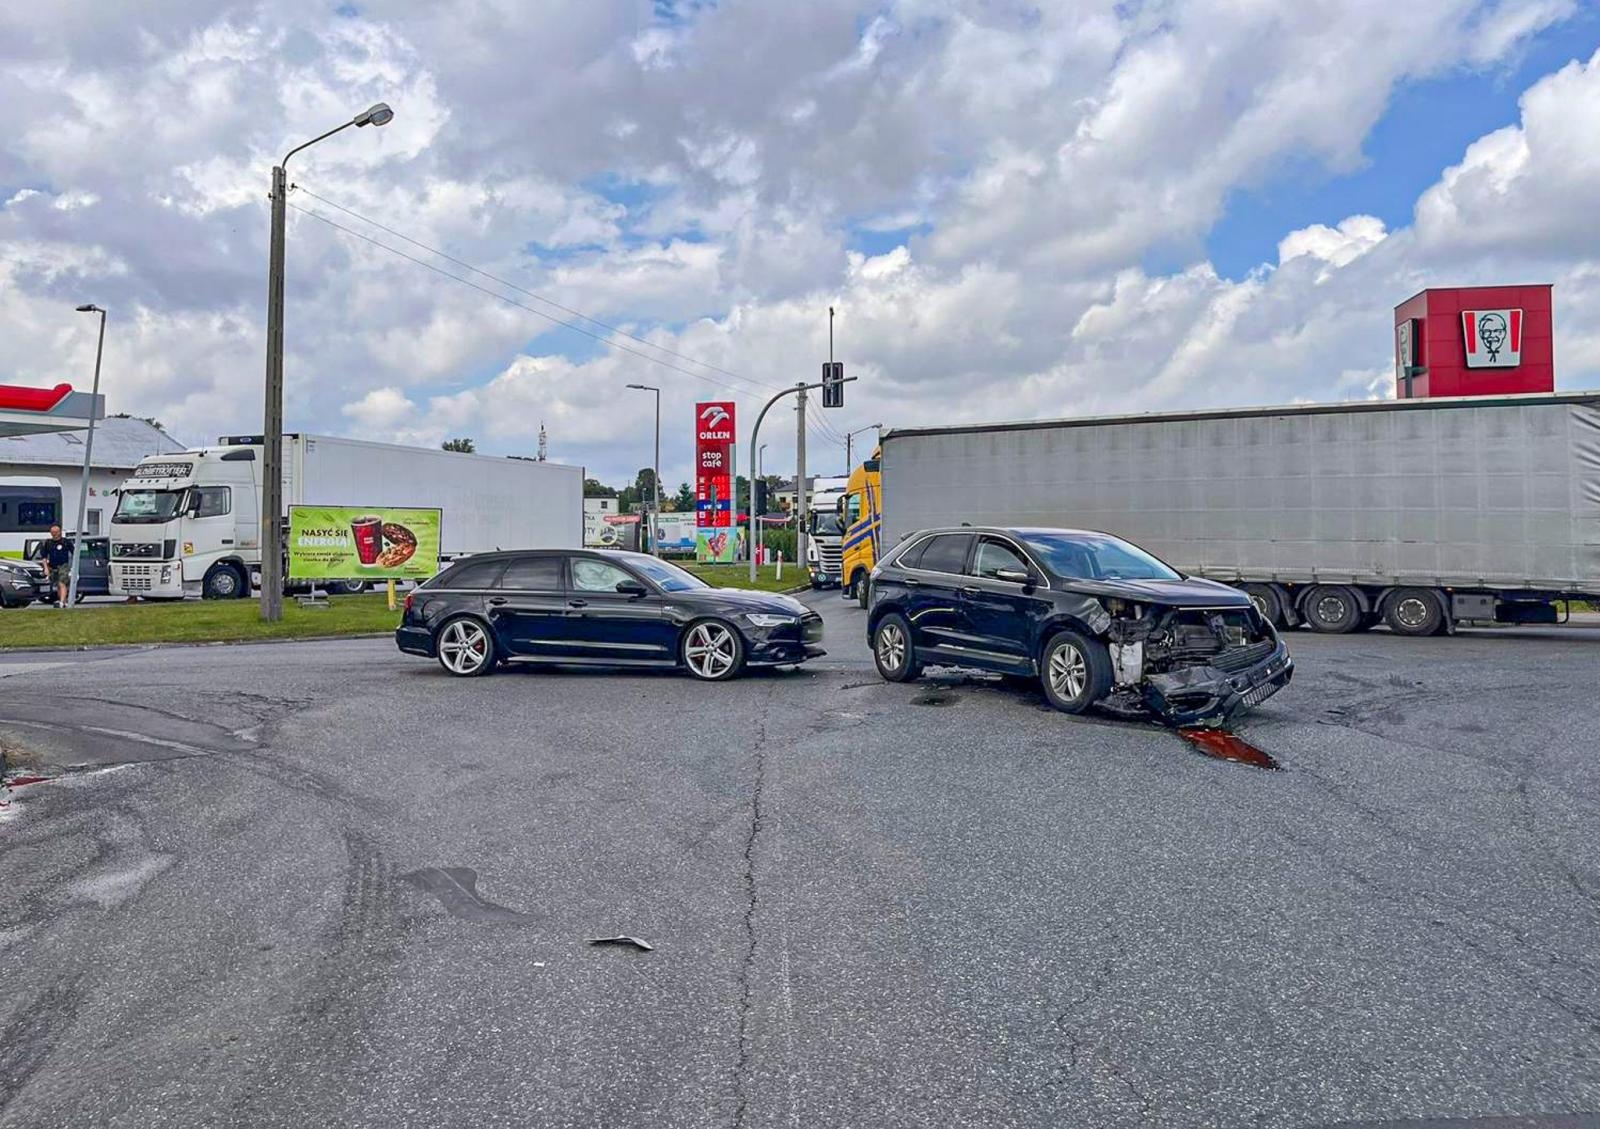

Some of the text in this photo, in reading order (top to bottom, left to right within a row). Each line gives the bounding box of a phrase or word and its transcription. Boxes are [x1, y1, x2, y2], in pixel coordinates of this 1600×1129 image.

[699, 431, 730, 440] ORLEN
[702, 452, 722, 460] stop
[702, 459, 722, 469] cafe
[301, 527, 334, 537] NASYĆ
